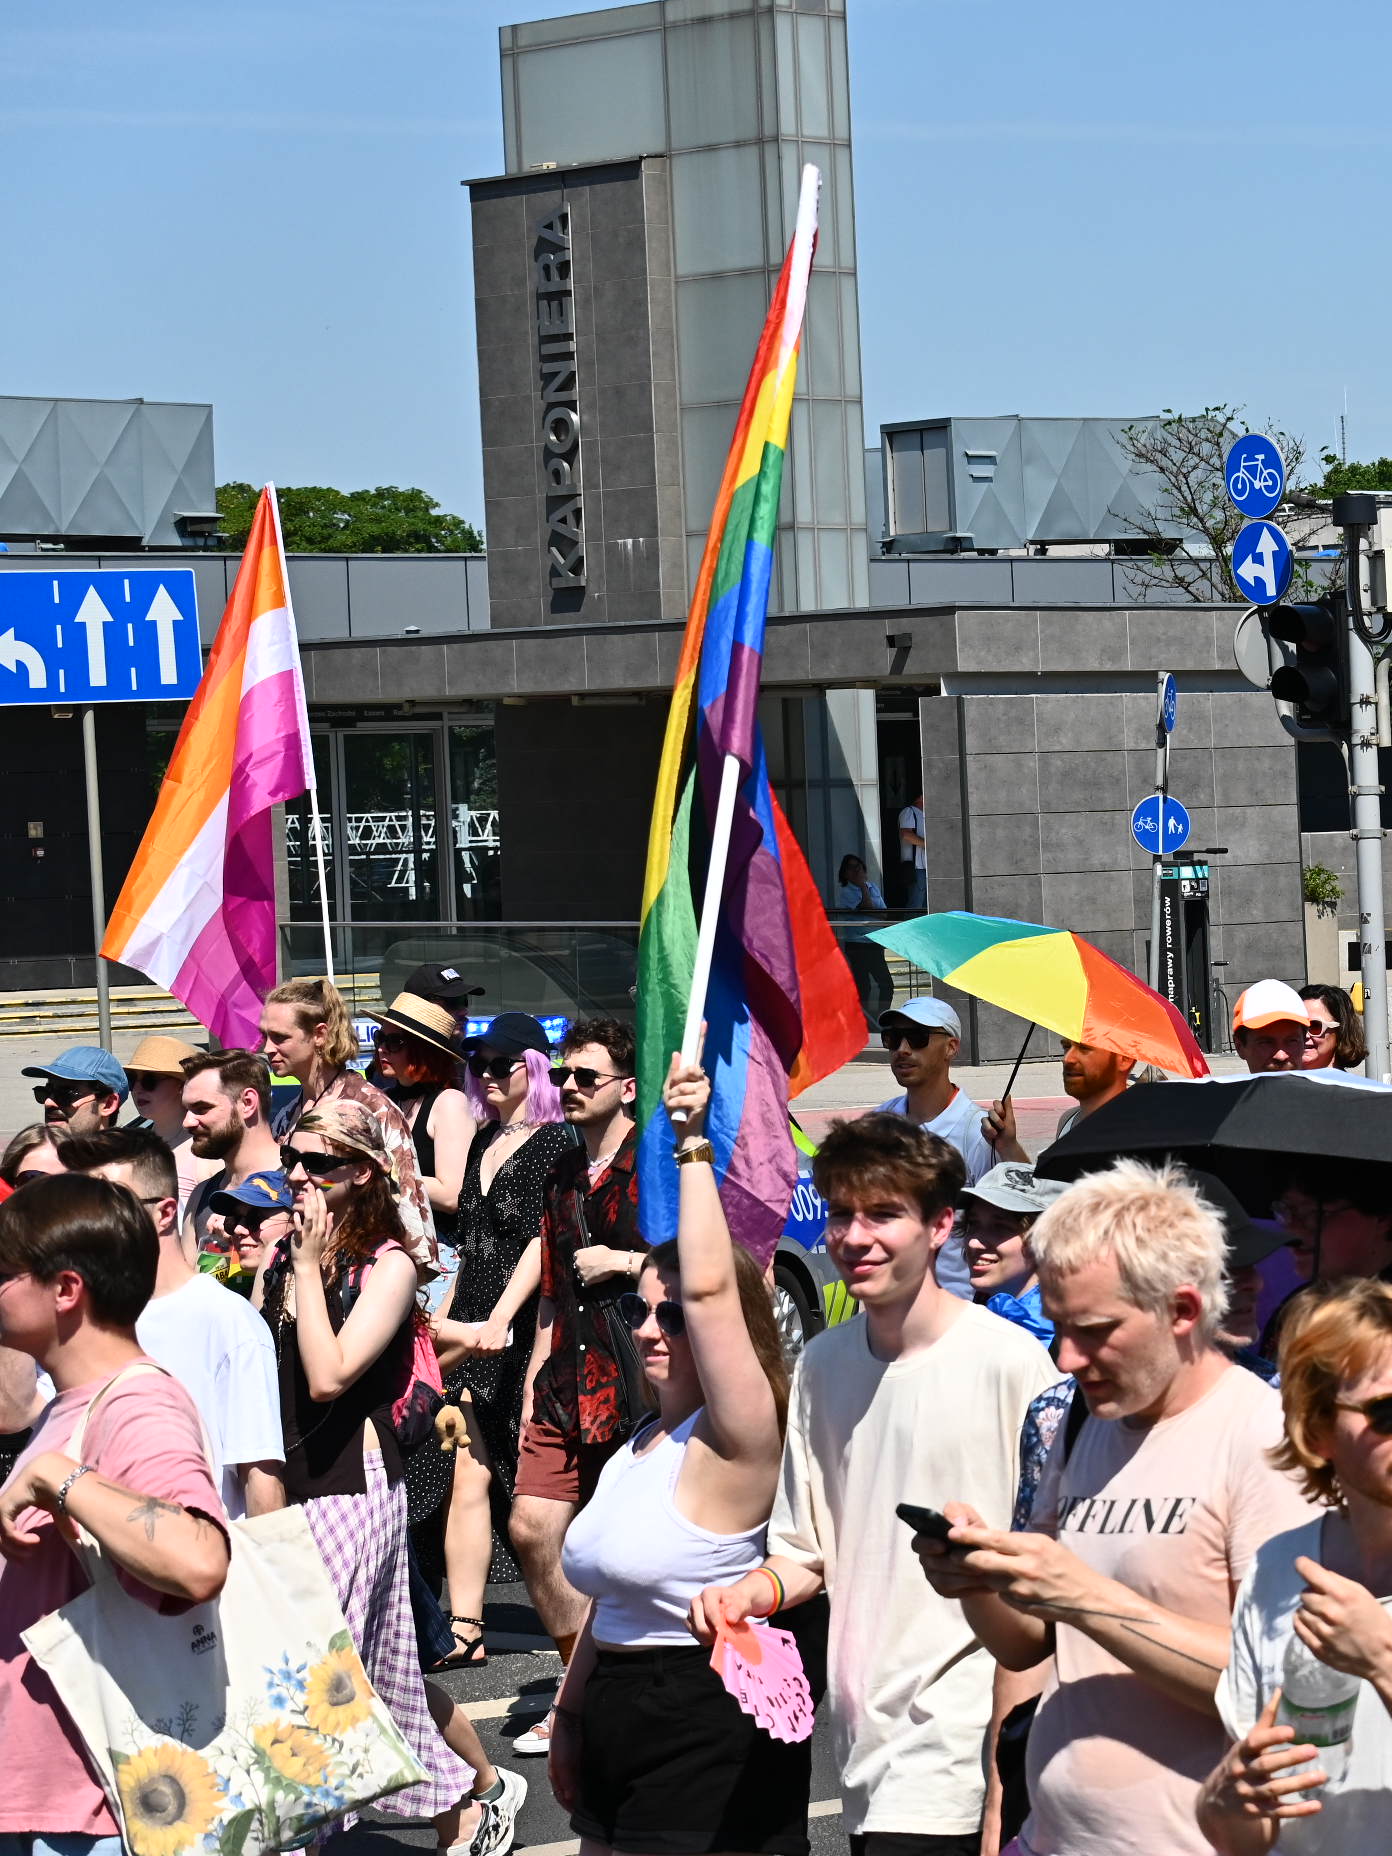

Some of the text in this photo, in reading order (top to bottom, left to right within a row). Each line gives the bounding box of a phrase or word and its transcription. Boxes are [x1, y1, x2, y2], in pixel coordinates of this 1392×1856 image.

[535, 202, 586, 589] KAPONIERA
[1163, 896, 1176, 1002] naprawy rowerów
[791, 1184, 829, 1221] 009
